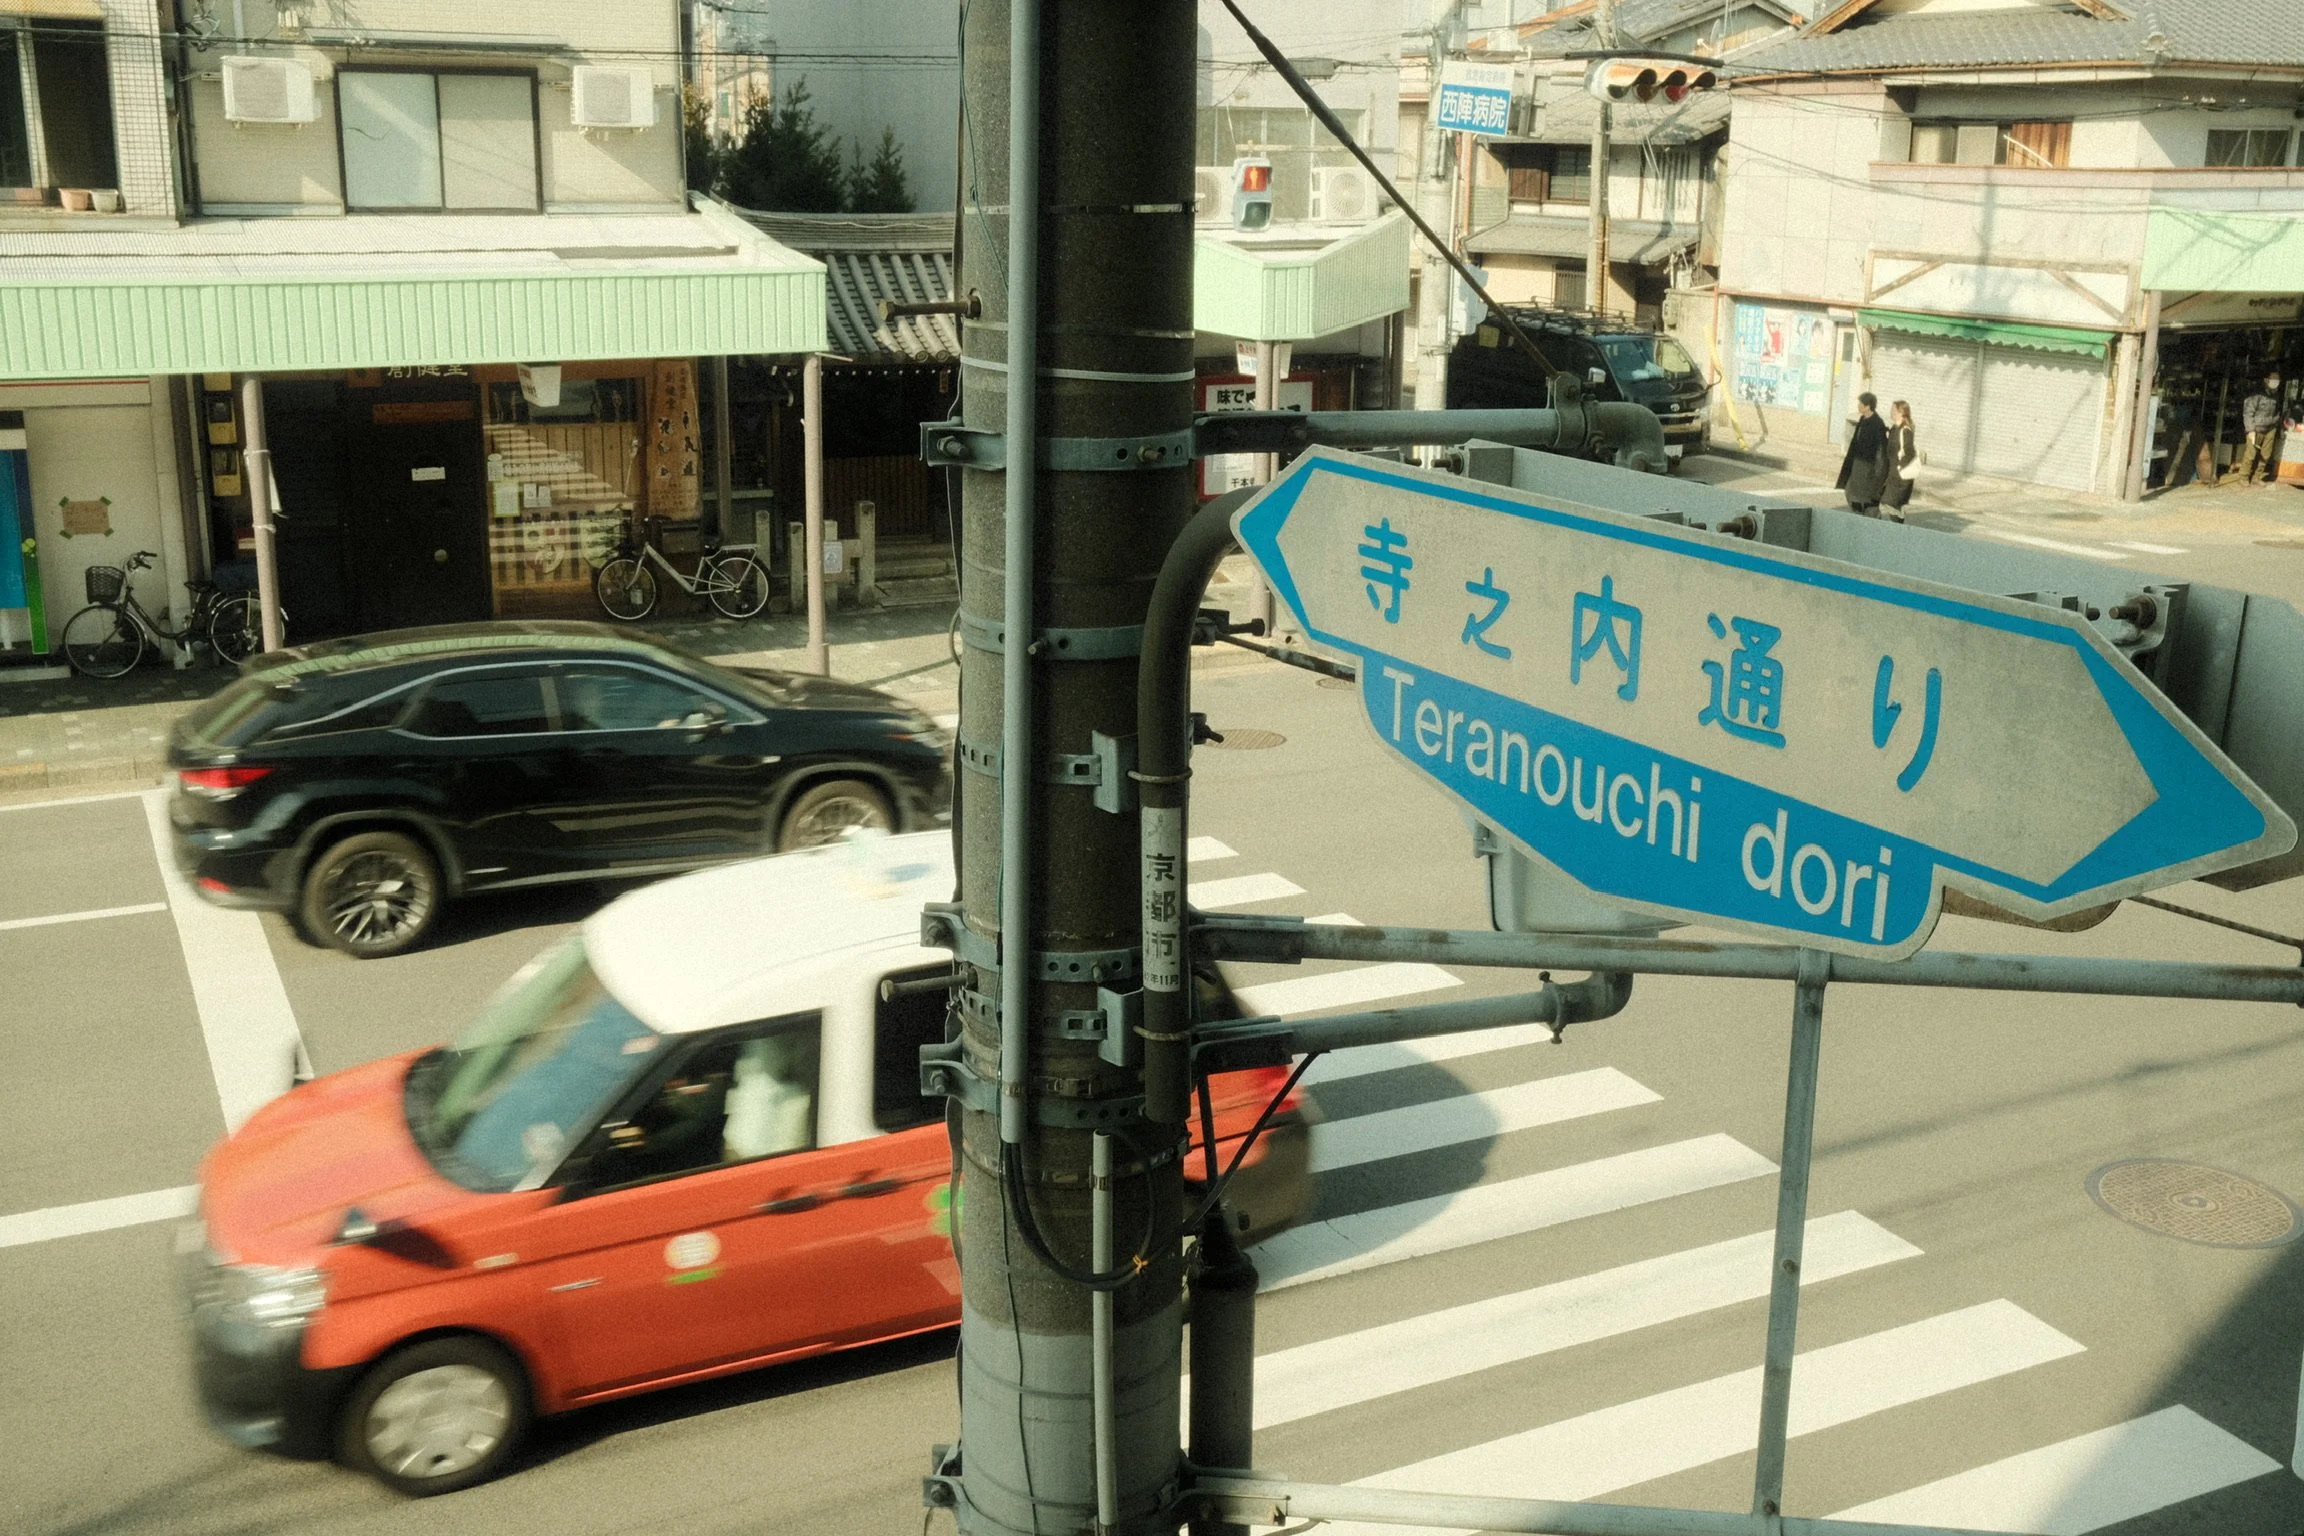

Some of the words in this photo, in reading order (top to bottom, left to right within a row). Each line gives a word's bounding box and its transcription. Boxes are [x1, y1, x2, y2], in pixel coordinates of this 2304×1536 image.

[1440, 90, 1507, 129] 西陣病院
[1359, 518, 1942, 793] 寺之内通り
[1381, 666, 1701, 861] Teranouchi
[1742, 809, 1889, 941] dori
[1145, 852, 1178, 960] 京都市
